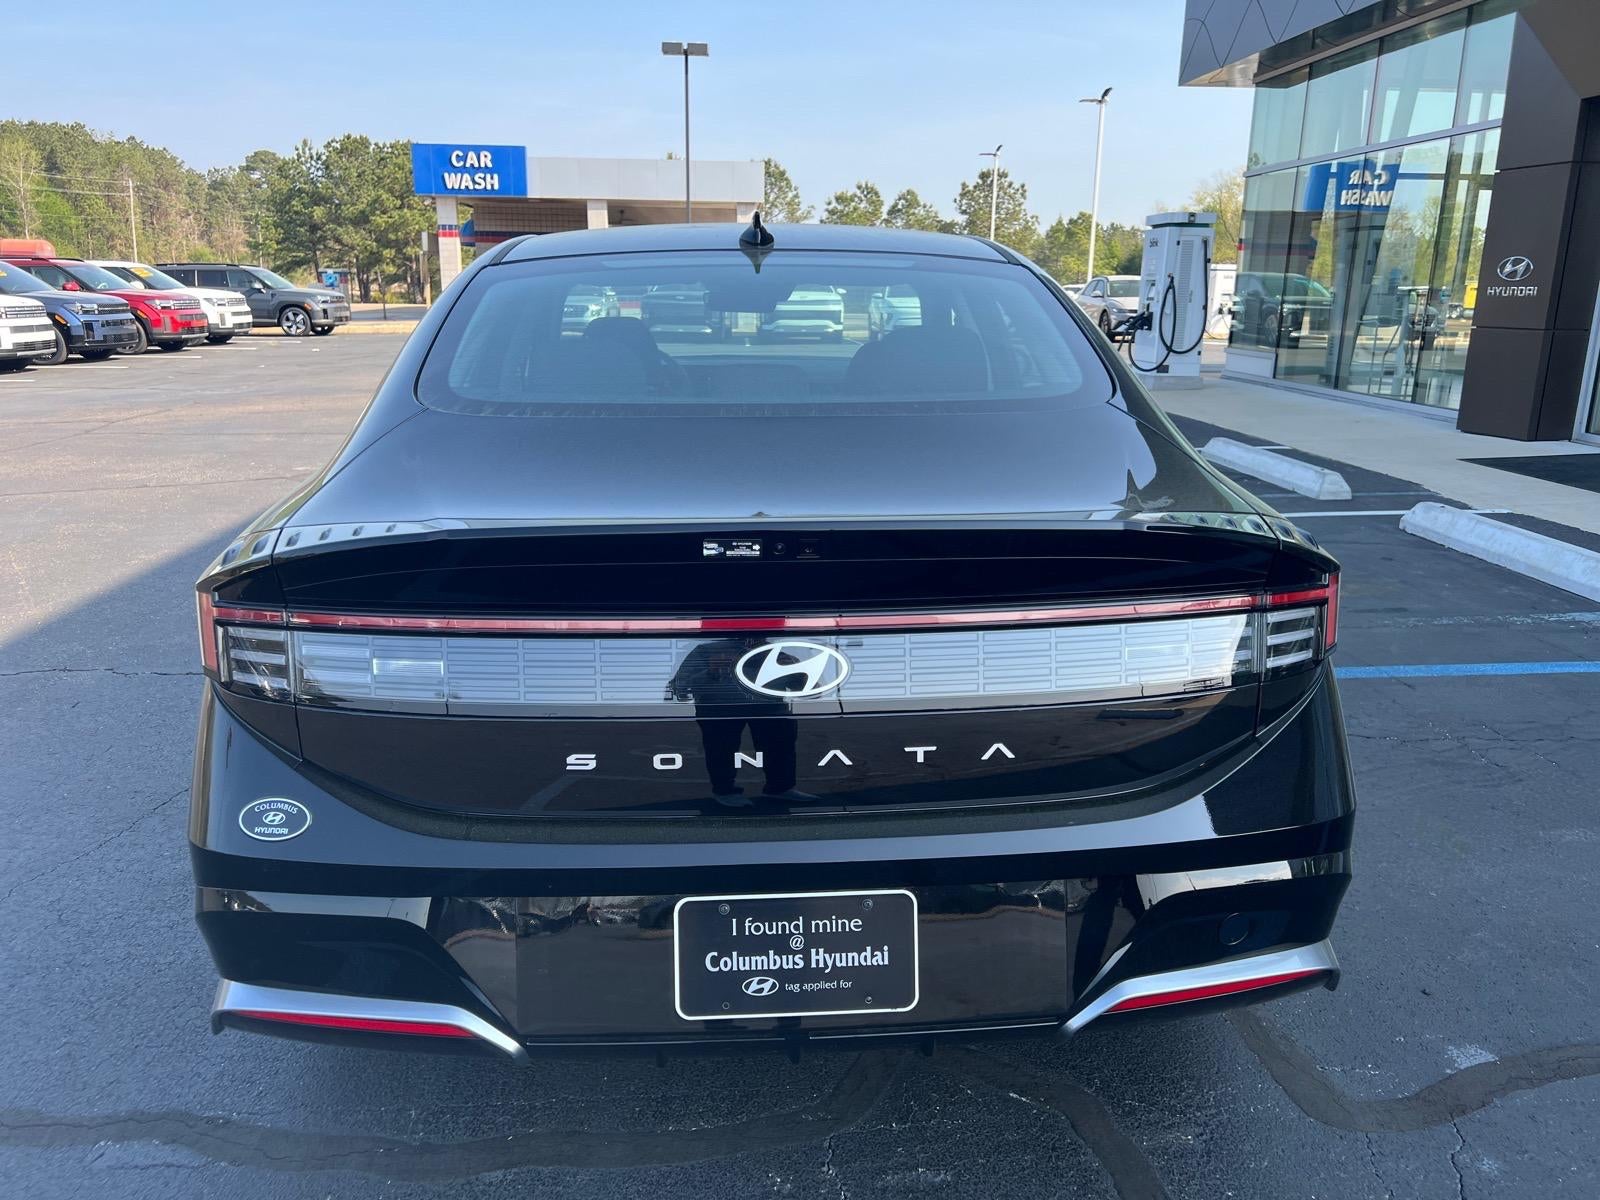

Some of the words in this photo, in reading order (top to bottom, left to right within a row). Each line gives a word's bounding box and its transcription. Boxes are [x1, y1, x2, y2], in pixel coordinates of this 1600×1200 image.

[451, 150, 493, 168] CAR
[443, 172, 499, 190] WASH
[1487, 286, 1538, 297] HYUNDAI
[565, 742, 1016, 771] SONATA
[254, 802, 298, 814] COLUMBUS
[254, 827, 289, 835] HYUNDAI
[731, 918, 737, 936] I
[744, 916, 804, 936] found
[811, 915, 863, 934] mine
[789, 934, 805, 950] @
[704, 949, 805, 972] Columbus
[810, 945, 889, 973] Hyundai
[785, 980, 801, 993] tag
[802, 979, 837, 991] applied
[839, 979, 853, 989] for
